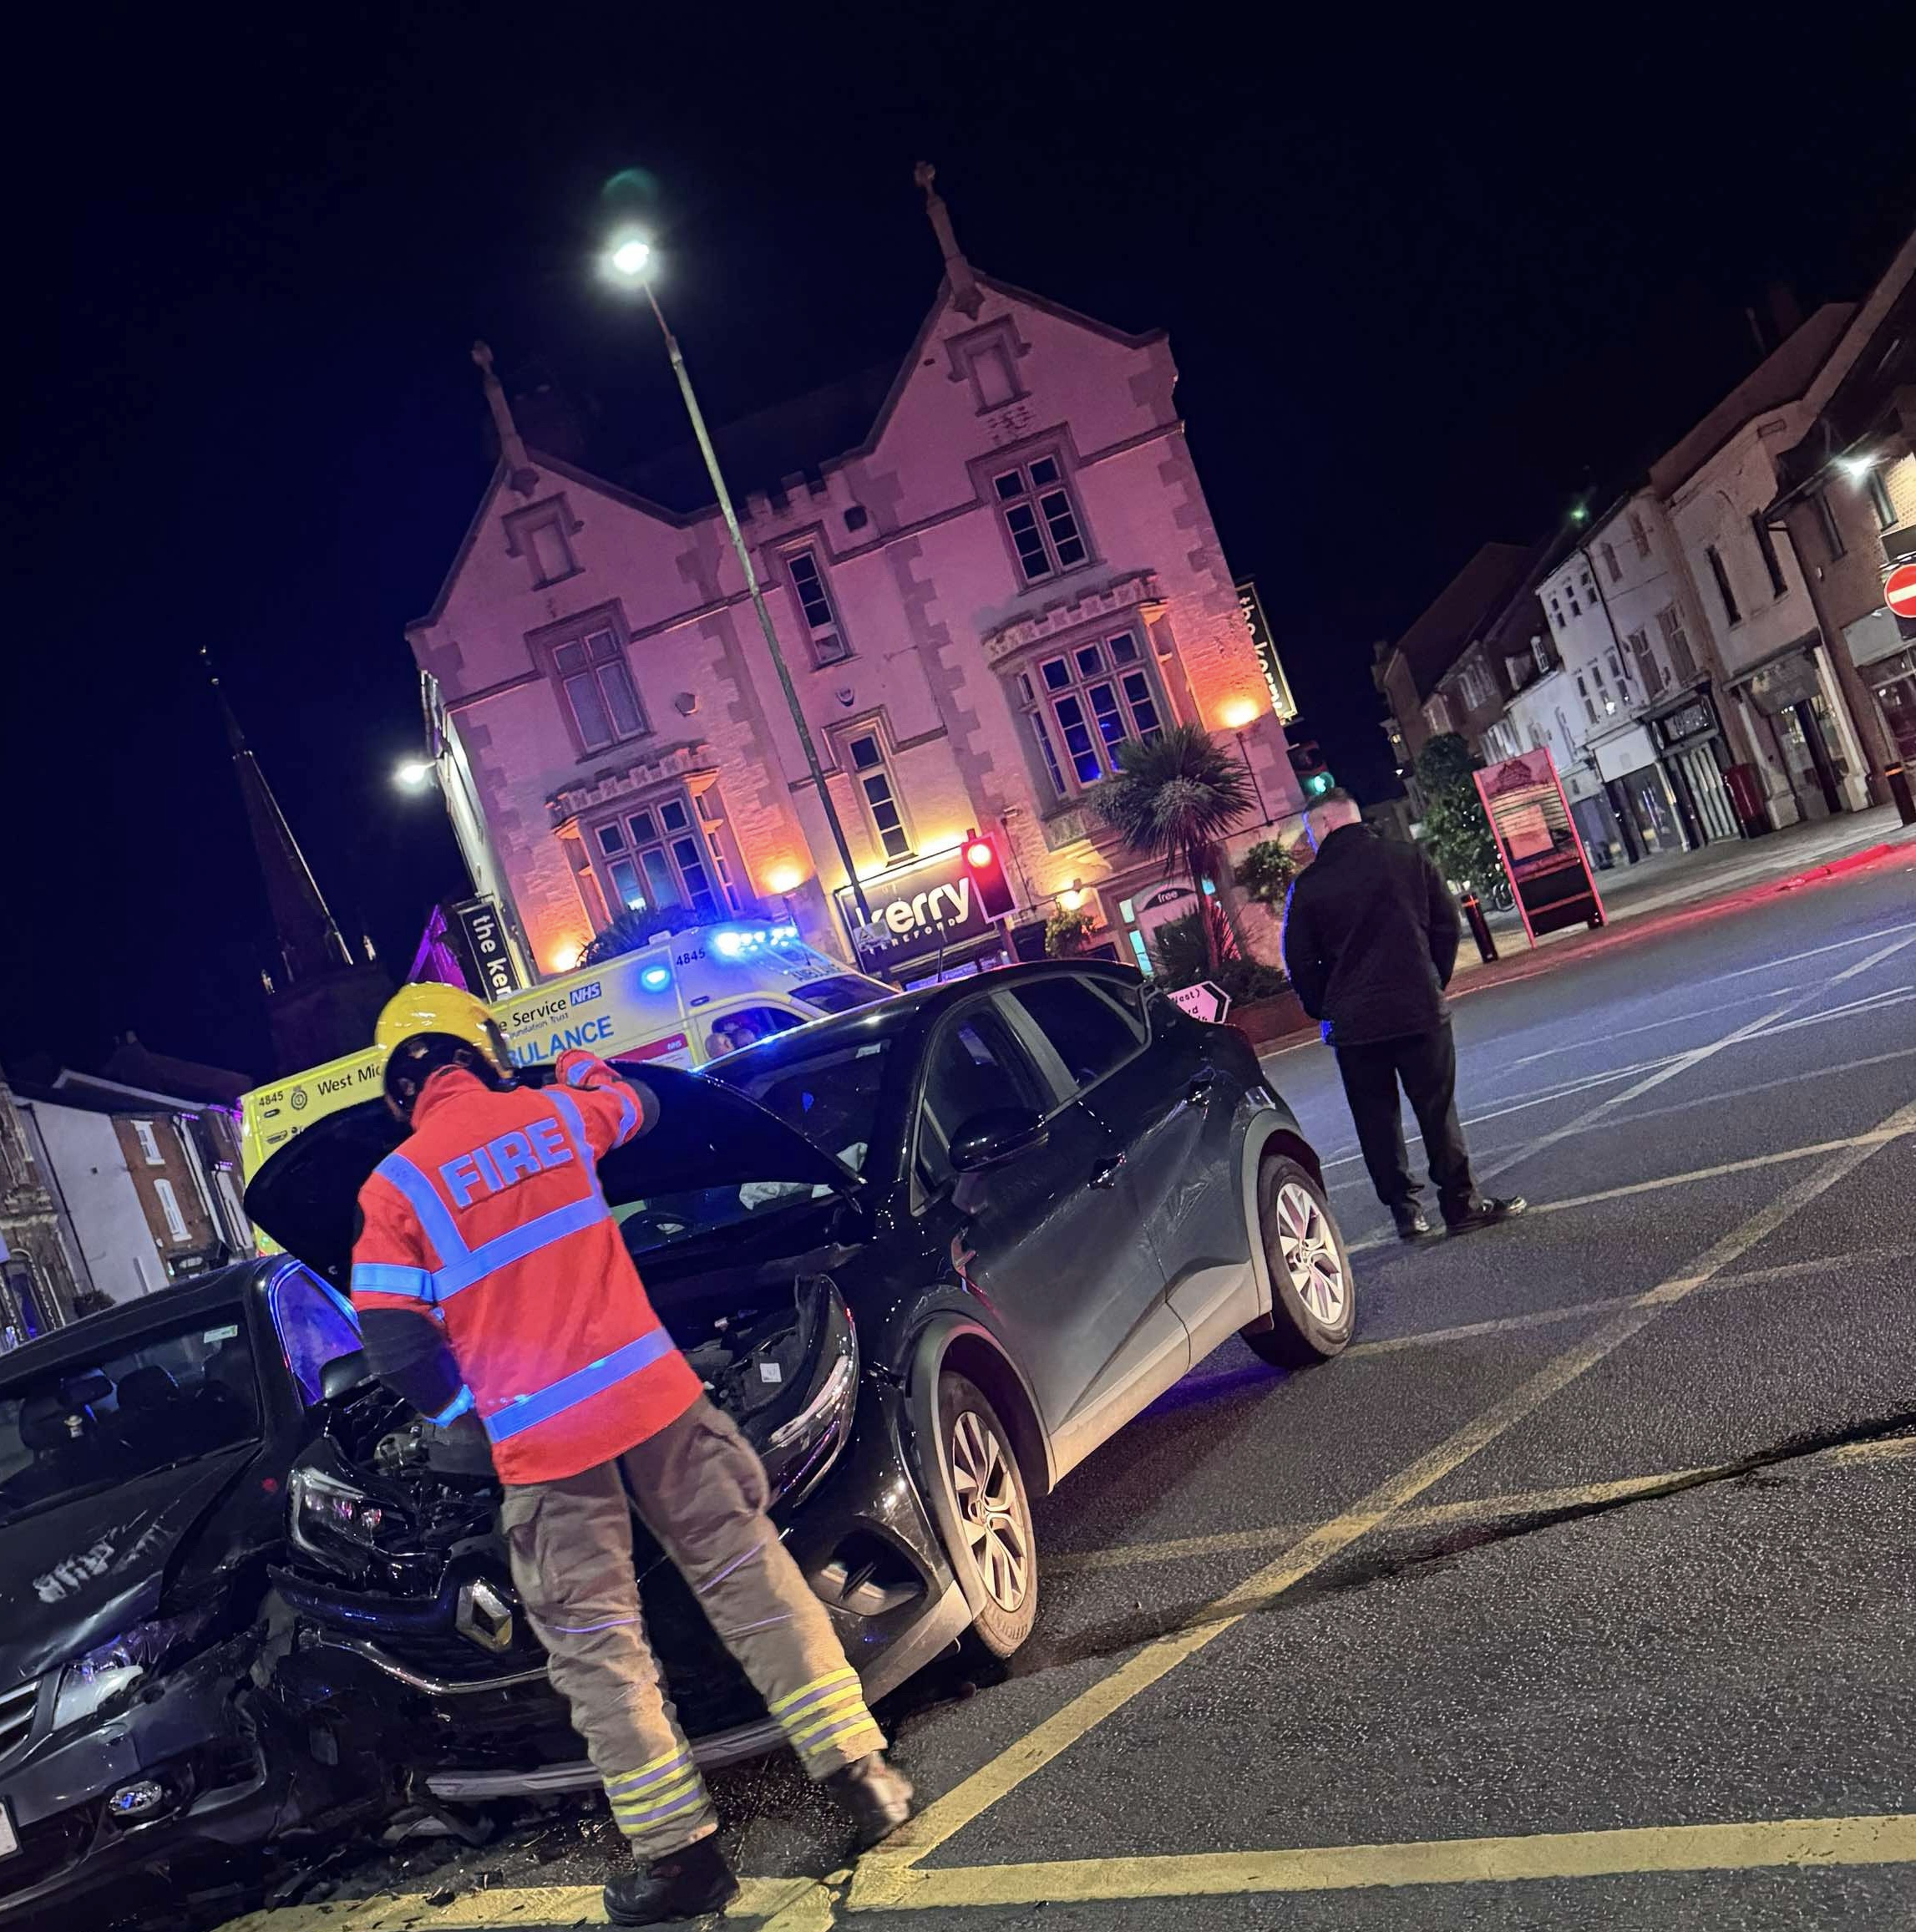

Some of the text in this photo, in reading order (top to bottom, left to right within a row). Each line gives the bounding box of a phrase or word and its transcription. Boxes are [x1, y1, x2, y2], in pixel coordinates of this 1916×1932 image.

[855, 877, 969, 934] kerry
[1158, 890, 1178, 904] free
[472, 915, 496, 954] the
[487, 956, 512, 996] ker
[676, 948, 706, 967] 4845
[513, 999, 567, 1027] Service
[571, 983, 601, 1005] NHS
[506, 1015, 615, 1067] BULANCE
[258, 1090, 284, 1108] 4845
[317, 1075, 353, 1097] West
[438, 1116, 575, 1209] FIRE
